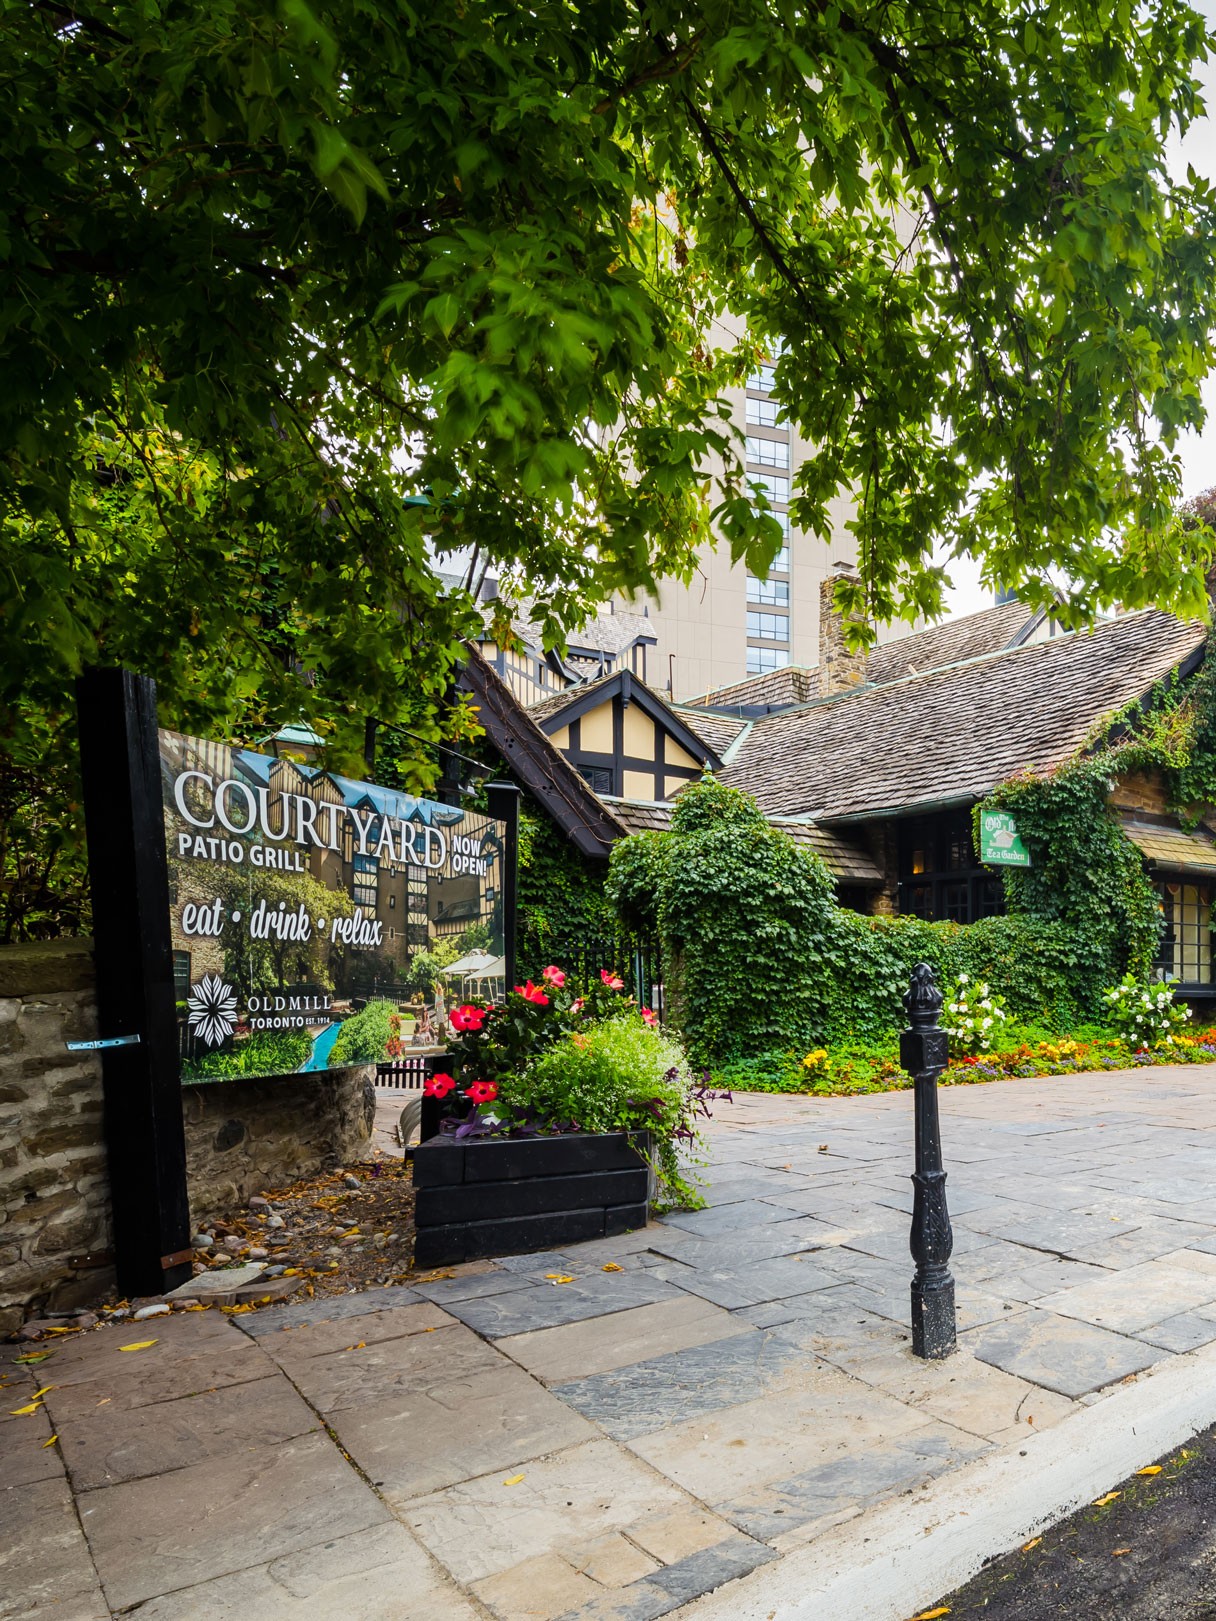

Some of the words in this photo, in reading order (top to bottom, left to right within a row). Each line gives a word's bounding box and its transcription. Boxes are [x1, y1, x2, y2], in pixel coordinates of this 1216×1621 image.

[174, 770, 447, 869] COURTYARD
[986, 816, 1001, 831] Old
[178, 832, 244, 863] PATIO
[249, 844, 305, 872] GRILL
[452, 834, 481, 858] NOW
[987, 848, 1000, 858] Tea
[1001, 850, 1024, 860] Garden
[452, 856, 487, 877] OPEN!
[182, 897, 225, 936] eat
[250, 898, 312, 942] drink
[331, 907, 383, 946] relax
[250, 1017, 304, 1029] TORONTO
